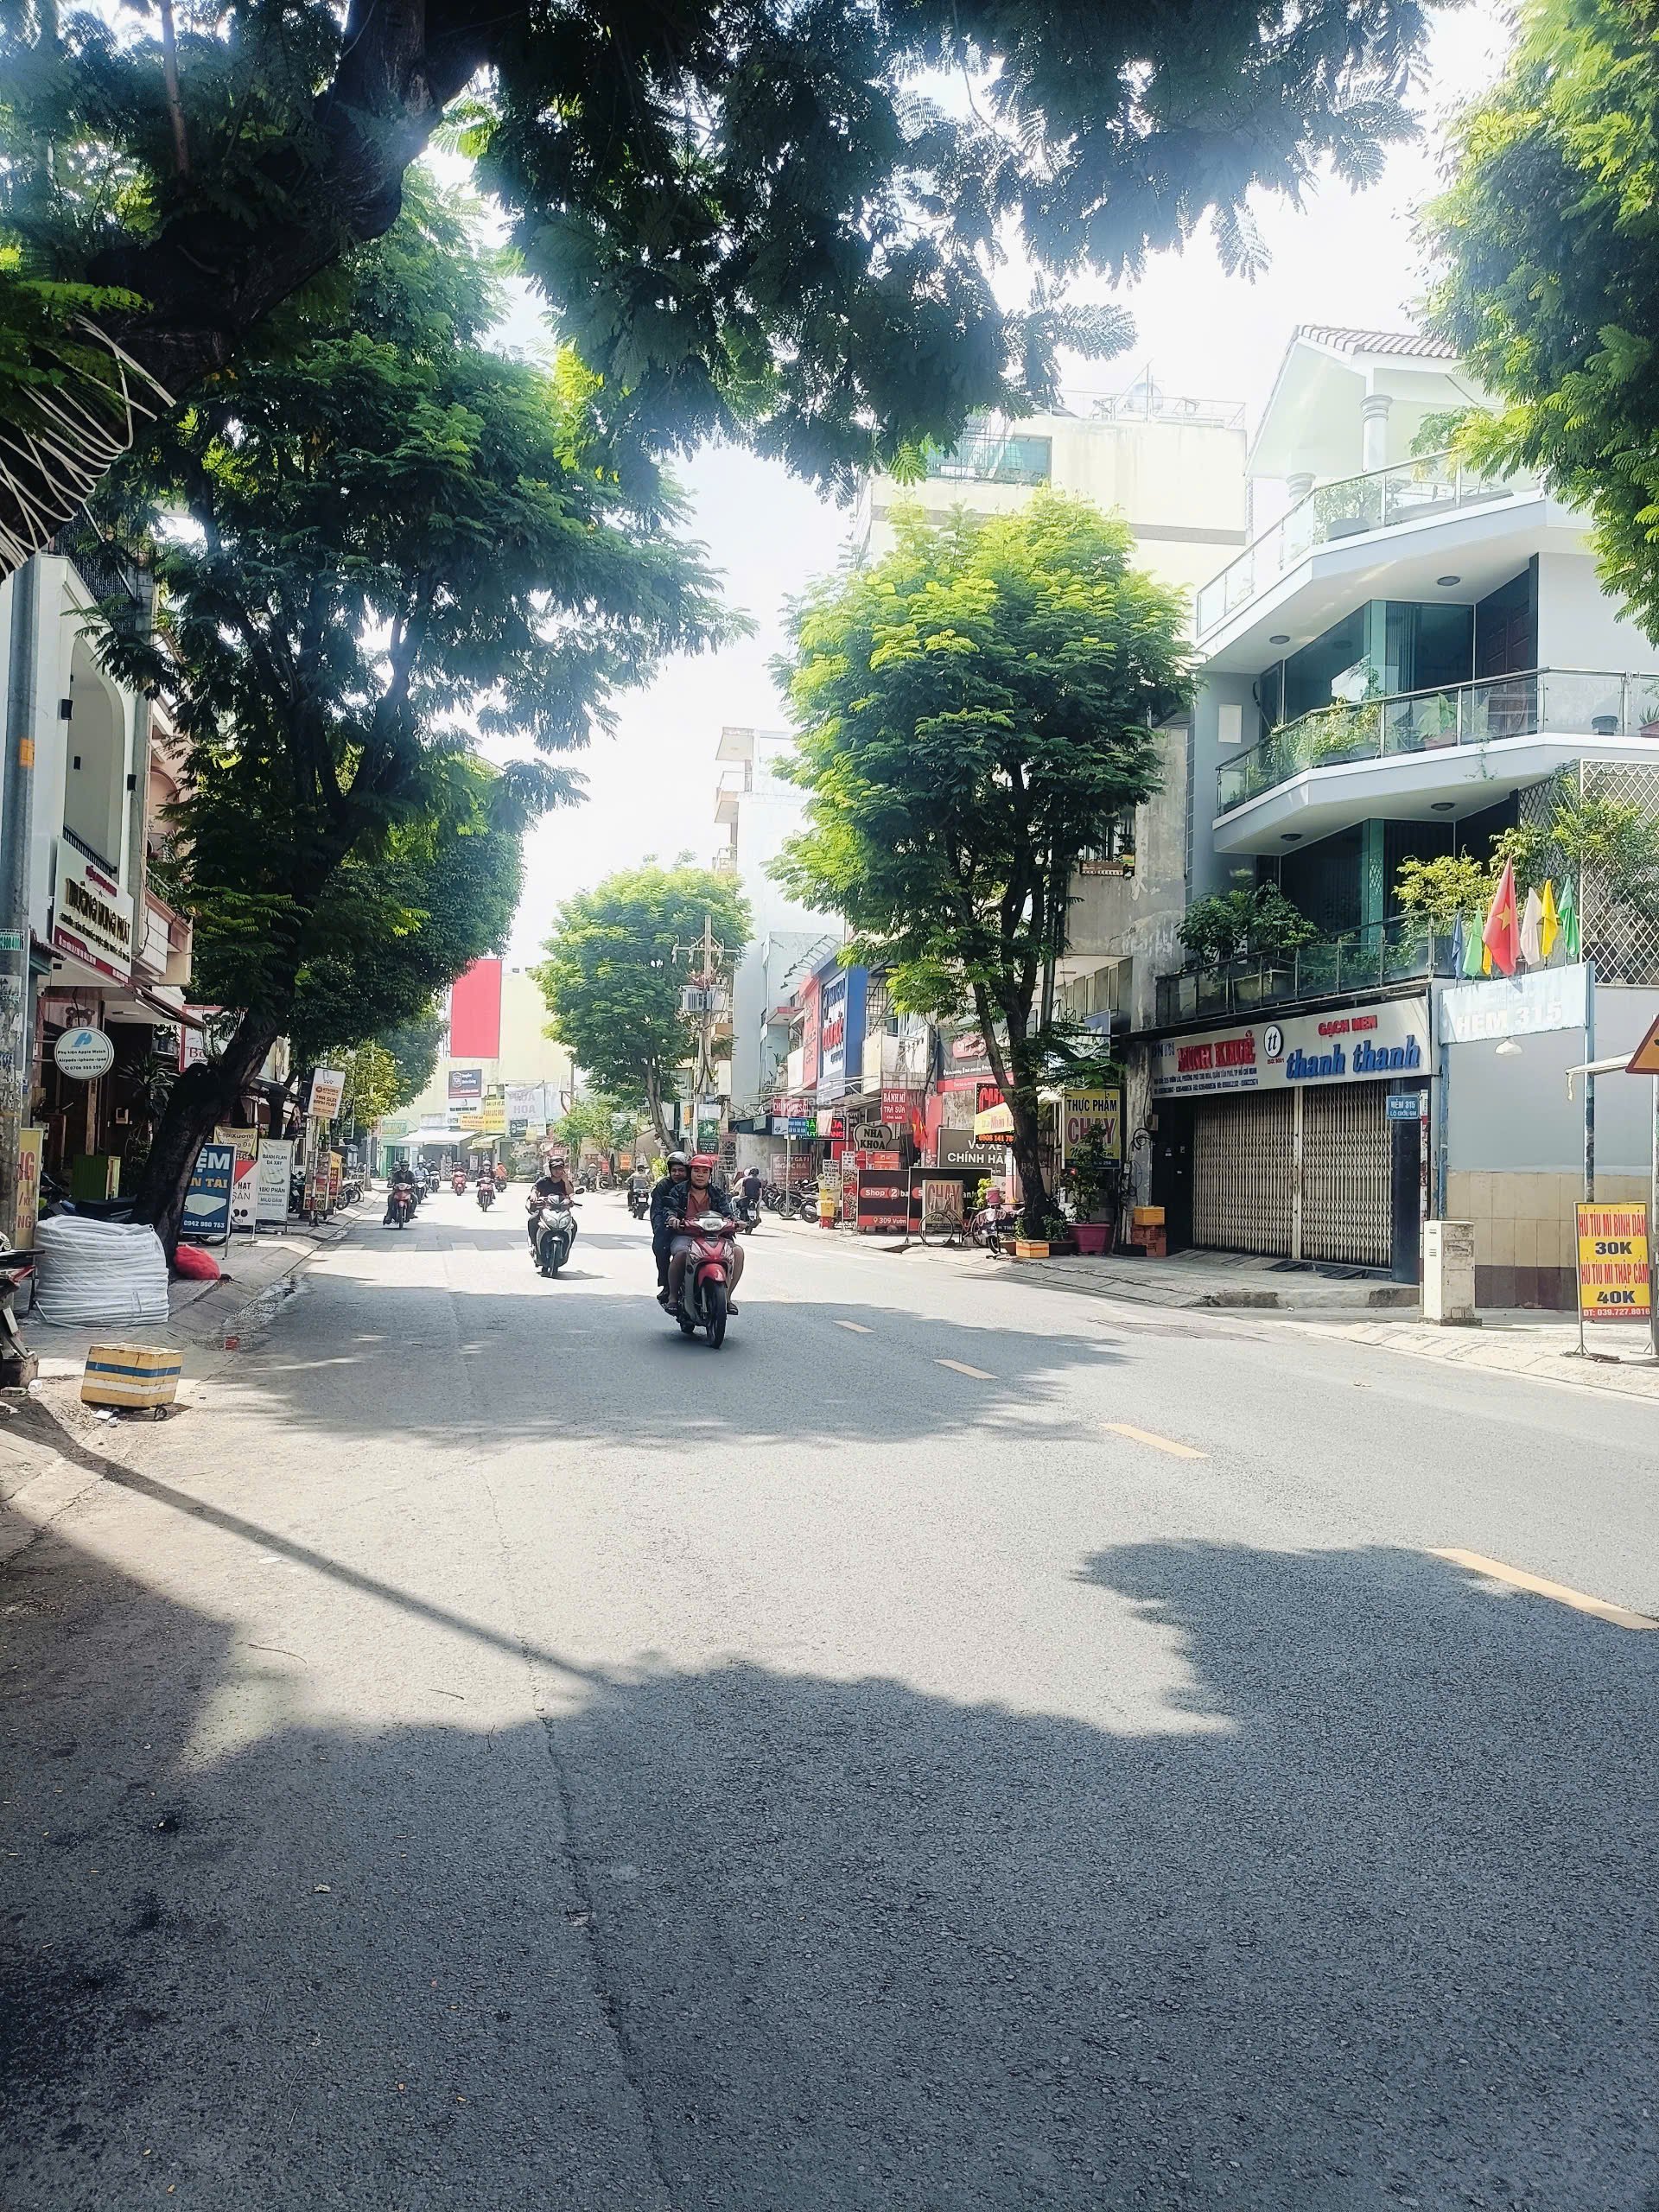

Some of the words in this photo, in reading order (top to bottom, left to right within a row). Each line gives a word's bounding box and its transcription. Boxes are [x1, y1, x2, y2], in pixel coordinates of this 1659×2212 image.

[1515, 1002, 1563, 1027] 315
[1319, 1020, 1350, 1037] GẠCH
[1286, 1044, 1346, 1080] thanh
[1353, 1035, 1421, 1073] thanh
[883, 1091, 899, 1103] BÁNH
[1066, 1097, 1090, 1114] THỰC
[1092, 1093, 1116, 1111] PHẨM
[864, 1128, 883, 1138] NHA
[1068, 1118, 1116, 1144] CHY
[861, 1140, 885, 1149] KHOA
[195, 1147, 231, 1173] ỆM
[947, 1151, 983, 1163] CHÍNH
[988, 1153, 1006, 1165] HÃ
[866, 1189, 885, 1198] Shop
[891, 1189, 897, 1198] 2
[1578, 1206, 1588, 1237] HỦ
[1590, 1209, 1601, 1237] TÍU
[1614, 1209, 1630, 1237] BÌNH
[1595, 1242, 1632, 1255] 30K
[1581, 1256, 1590, 1285] HỦ
[1592, 1260, 1602, 1285] TÍU
[1614, 1260, 1631, 1289] THẬP
[1597, 1291, 1635, 1304] 40K
